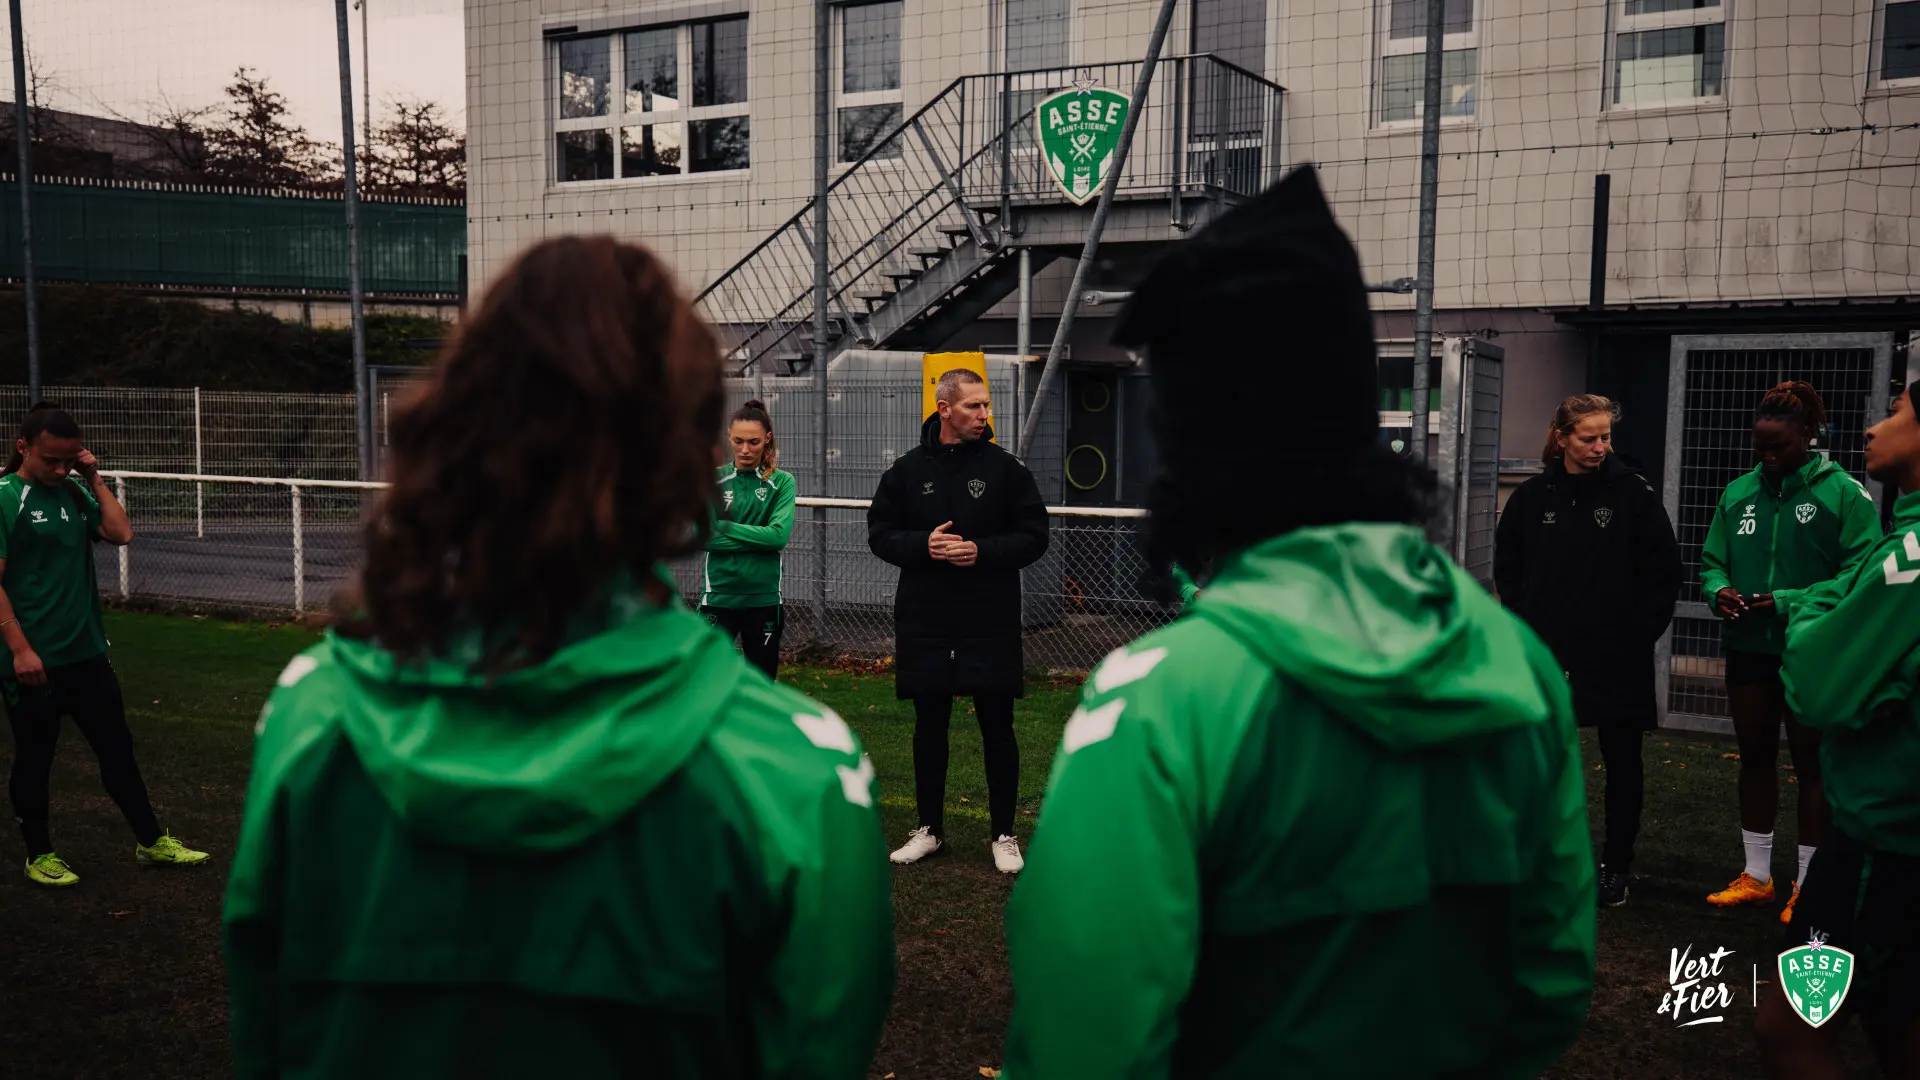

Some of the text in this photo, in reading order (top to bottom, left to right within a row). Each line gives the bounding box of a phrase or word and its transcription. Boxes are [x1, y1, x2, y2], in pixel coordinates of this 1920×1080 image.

[1049, 100, 1122, 130] ASSE
[1057, 122, 1108, 136] SAINT-ÉTIENNE
[60, 506, 69, 522] 4
[1737, 518, 1756, 535] 20
[763, 632, 773, 646] 7
